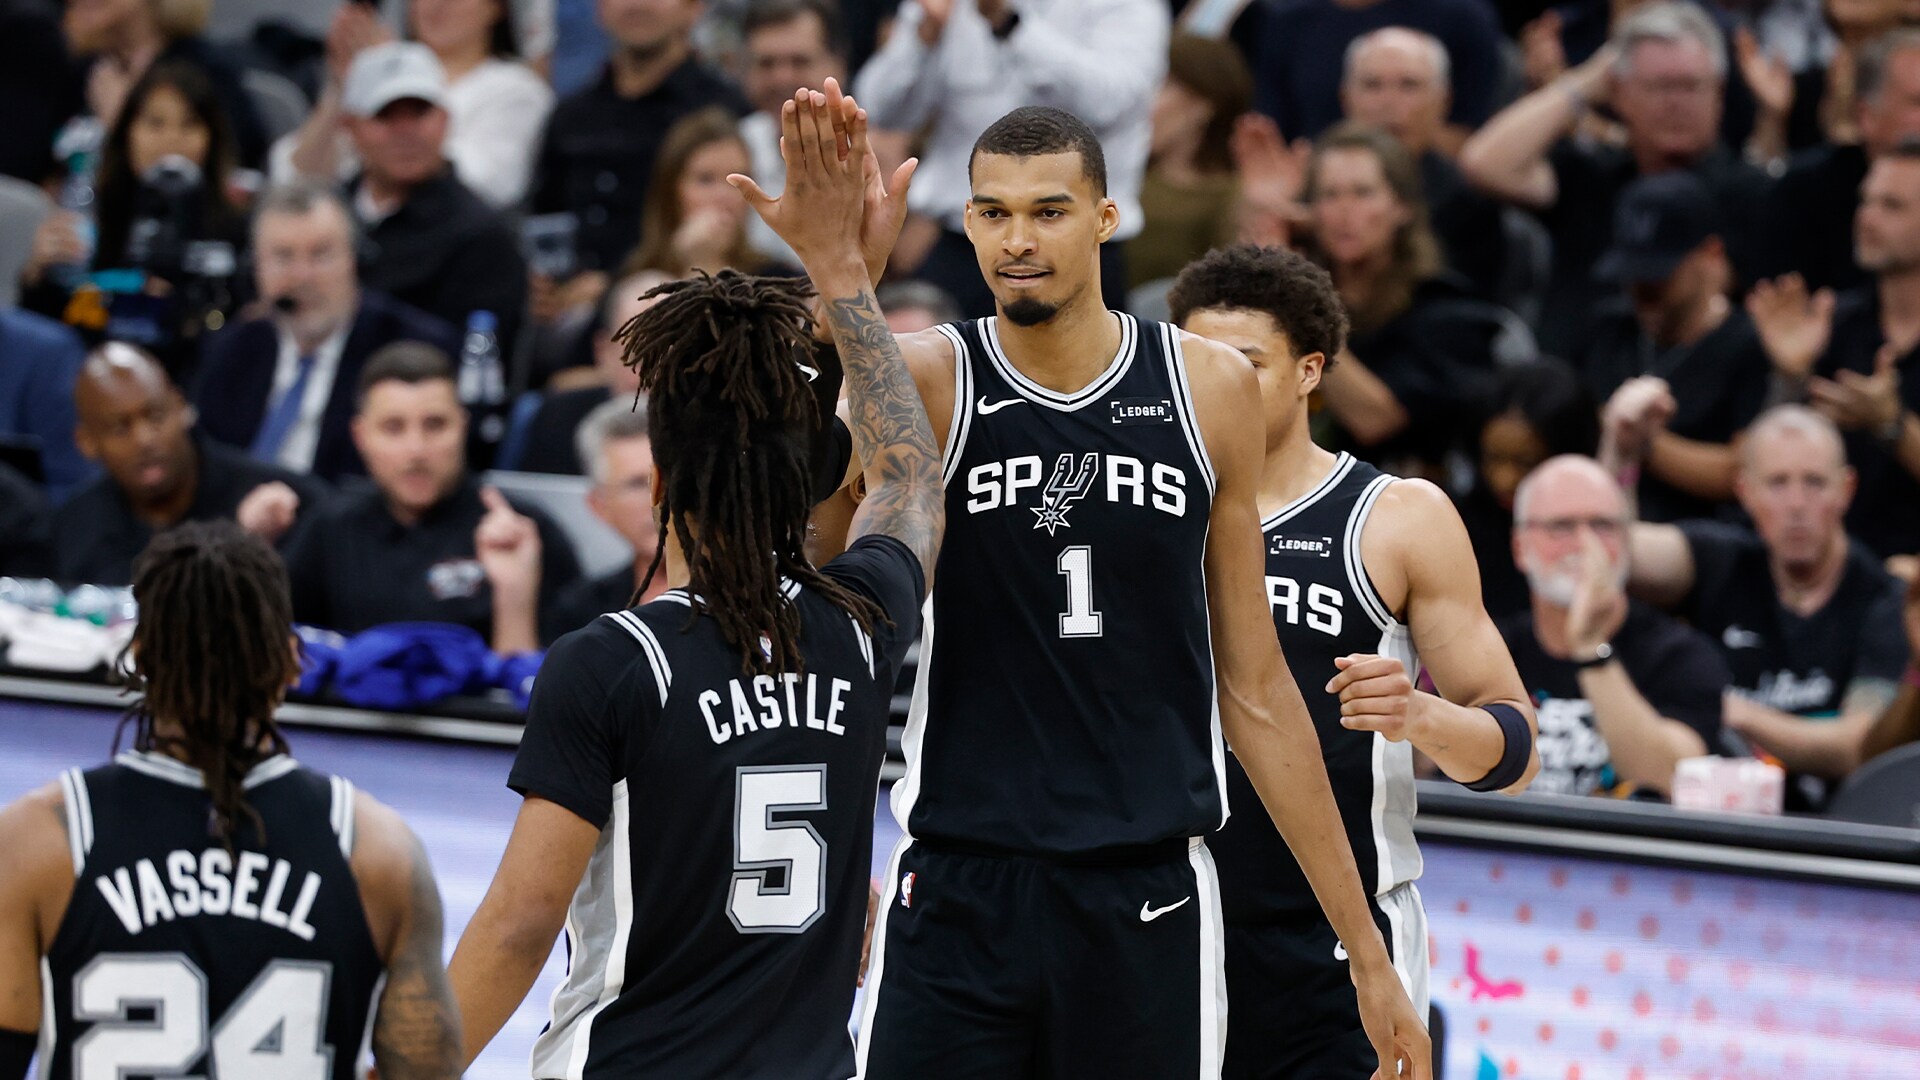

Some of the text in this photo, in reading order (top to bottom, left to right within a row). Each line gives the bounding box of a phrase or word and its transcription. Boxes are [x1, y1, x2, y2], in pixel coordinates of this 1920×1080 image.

[1119, 406, 1165, 417] LEDGER
[967, 452, 1187, 538] SPURS
[1278, 539, 1324, 551] LEDGER
[1057, 545, 1103, 638] 1
[698, 672, 852, 745] CASTLE
[725, 763, 828, 934] 5
[95, 847, 322, 942] VASSELL
[72, 952, 337, 1080] 24
